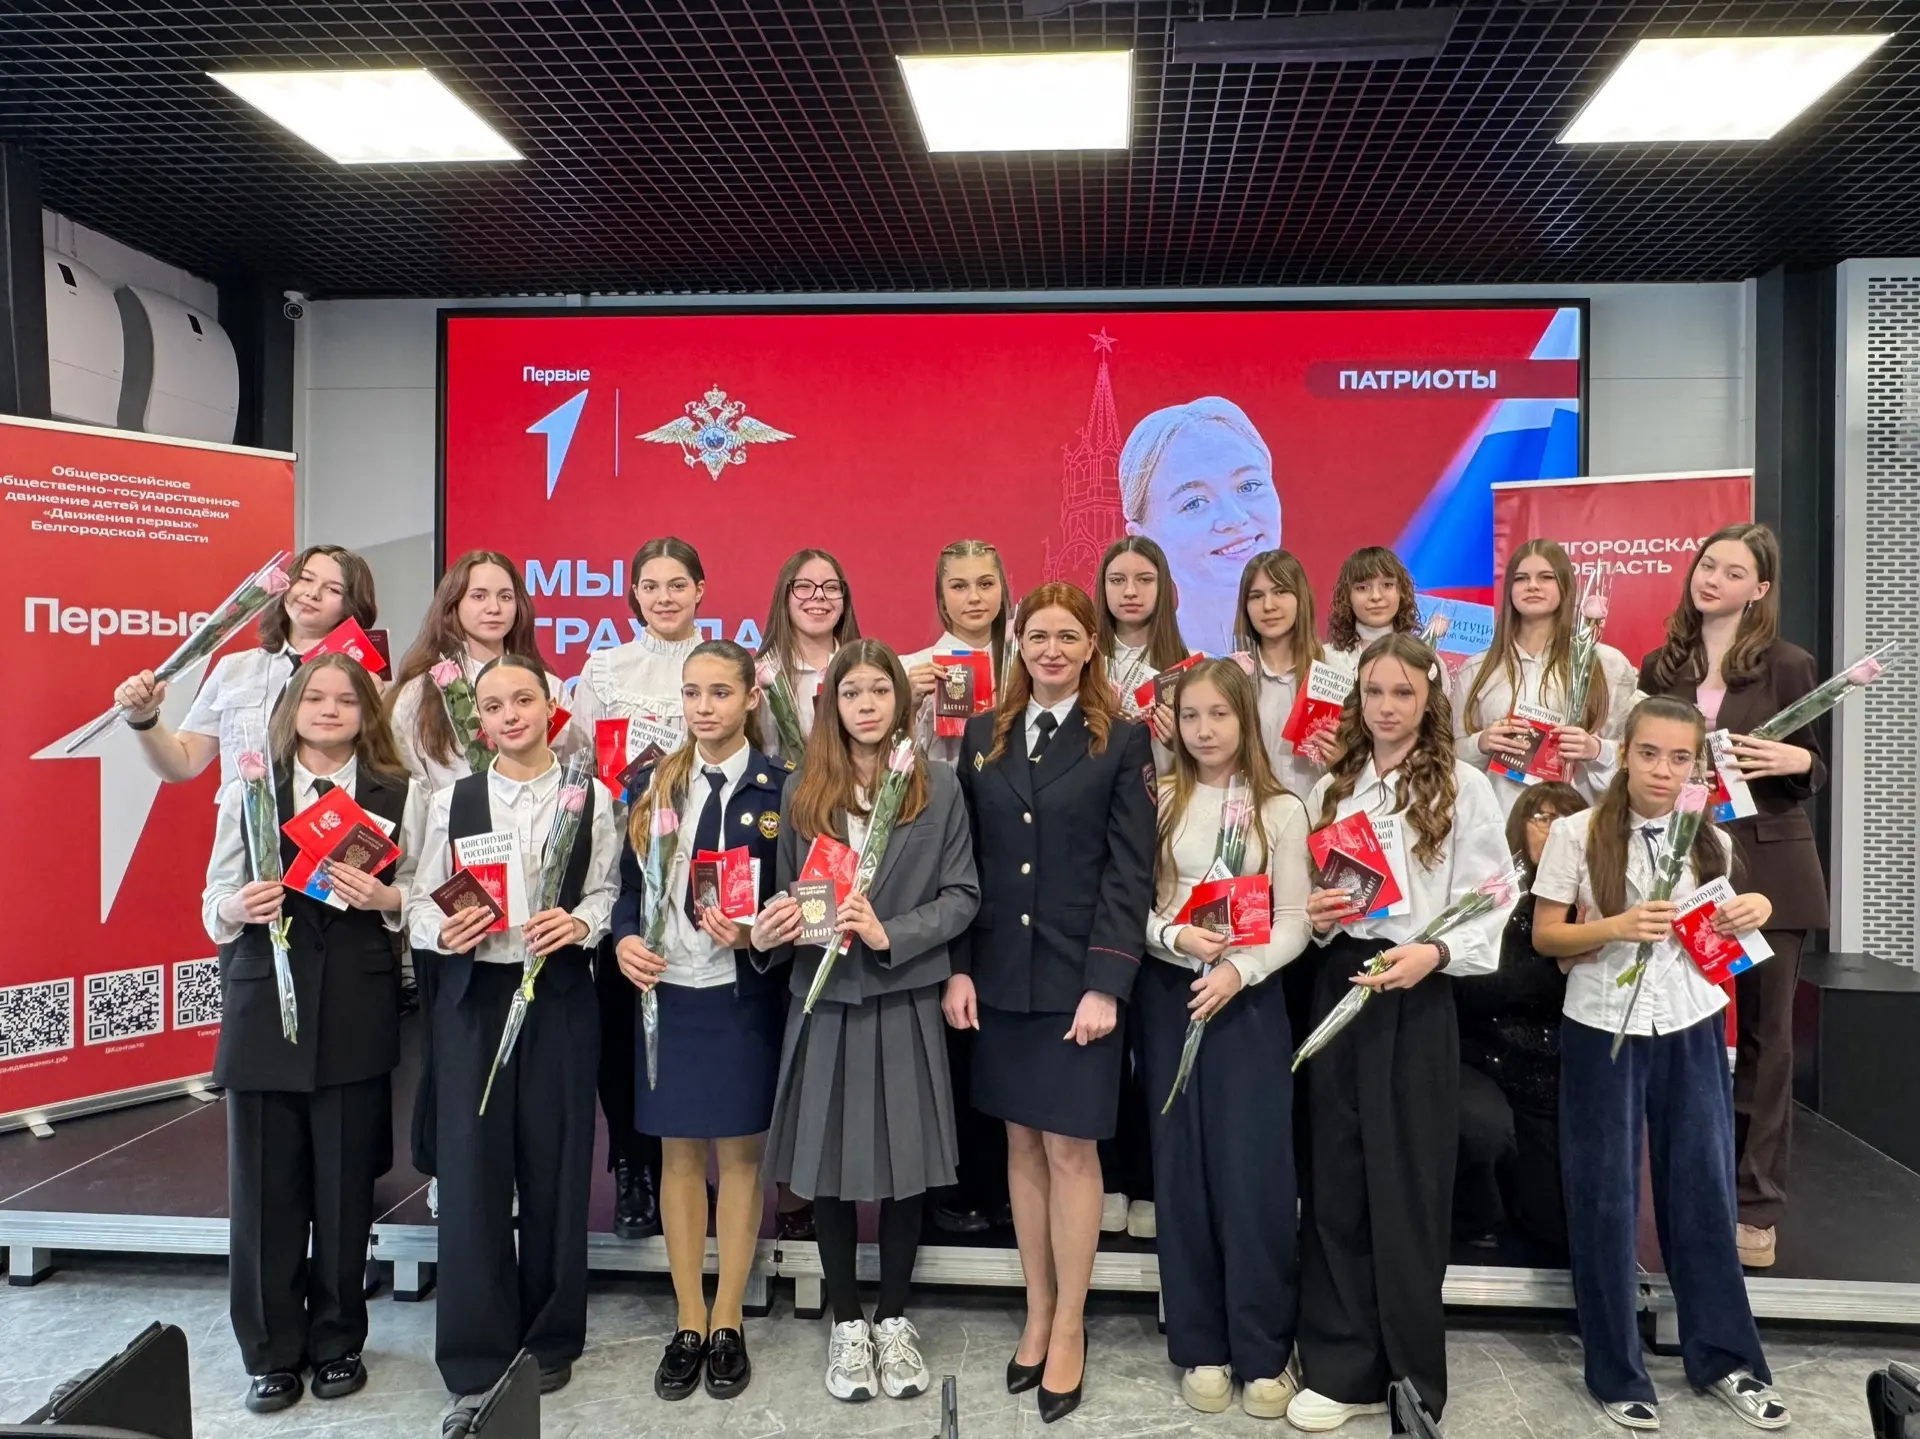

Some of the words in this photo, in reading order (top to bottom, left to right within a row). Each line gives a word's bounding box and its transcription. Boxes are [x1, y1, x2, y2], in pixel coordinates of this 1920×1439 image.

[523, 366, 591, 386] Первые
[1338, 369, 1497, 390] ПАТРИОТЫ
[52, 465, 191, 490] Общероссийское
[0, 474, 241, 508] бщественно-государственное
[5, 491, 90, 507] движение
[92, 498, 139, 512] детей
[142, 504, 151, 512] и
[154, 504, 229, 520] молодёжи
[43, 508, 134, 524] «Движения
[136, 516, 199, 529] первых»
[31, 520, 146, 539] Белгородской
[149, 529, 209, 544] области
[1557, 536, 1711, 556] ЛГОРОДСКА
[525, 559, 624, 597] МЫ
[1571, 559, 1673, 575] ОБЛАСТЬ
[24, 596, 213, 646] Первые
[1313, 665, 1353, 686] КОНСТИТУЦИ
[632, 718, 678, 741] КОНСТИТУЦИЯ
[460, 832, 513, 850] КОНСТИТУЦИЯ
[463, 842, 512, 860] РОССИЙСКОЙ
[1675, 883, 1724, 914] ОНСТИТУЦИЯ
